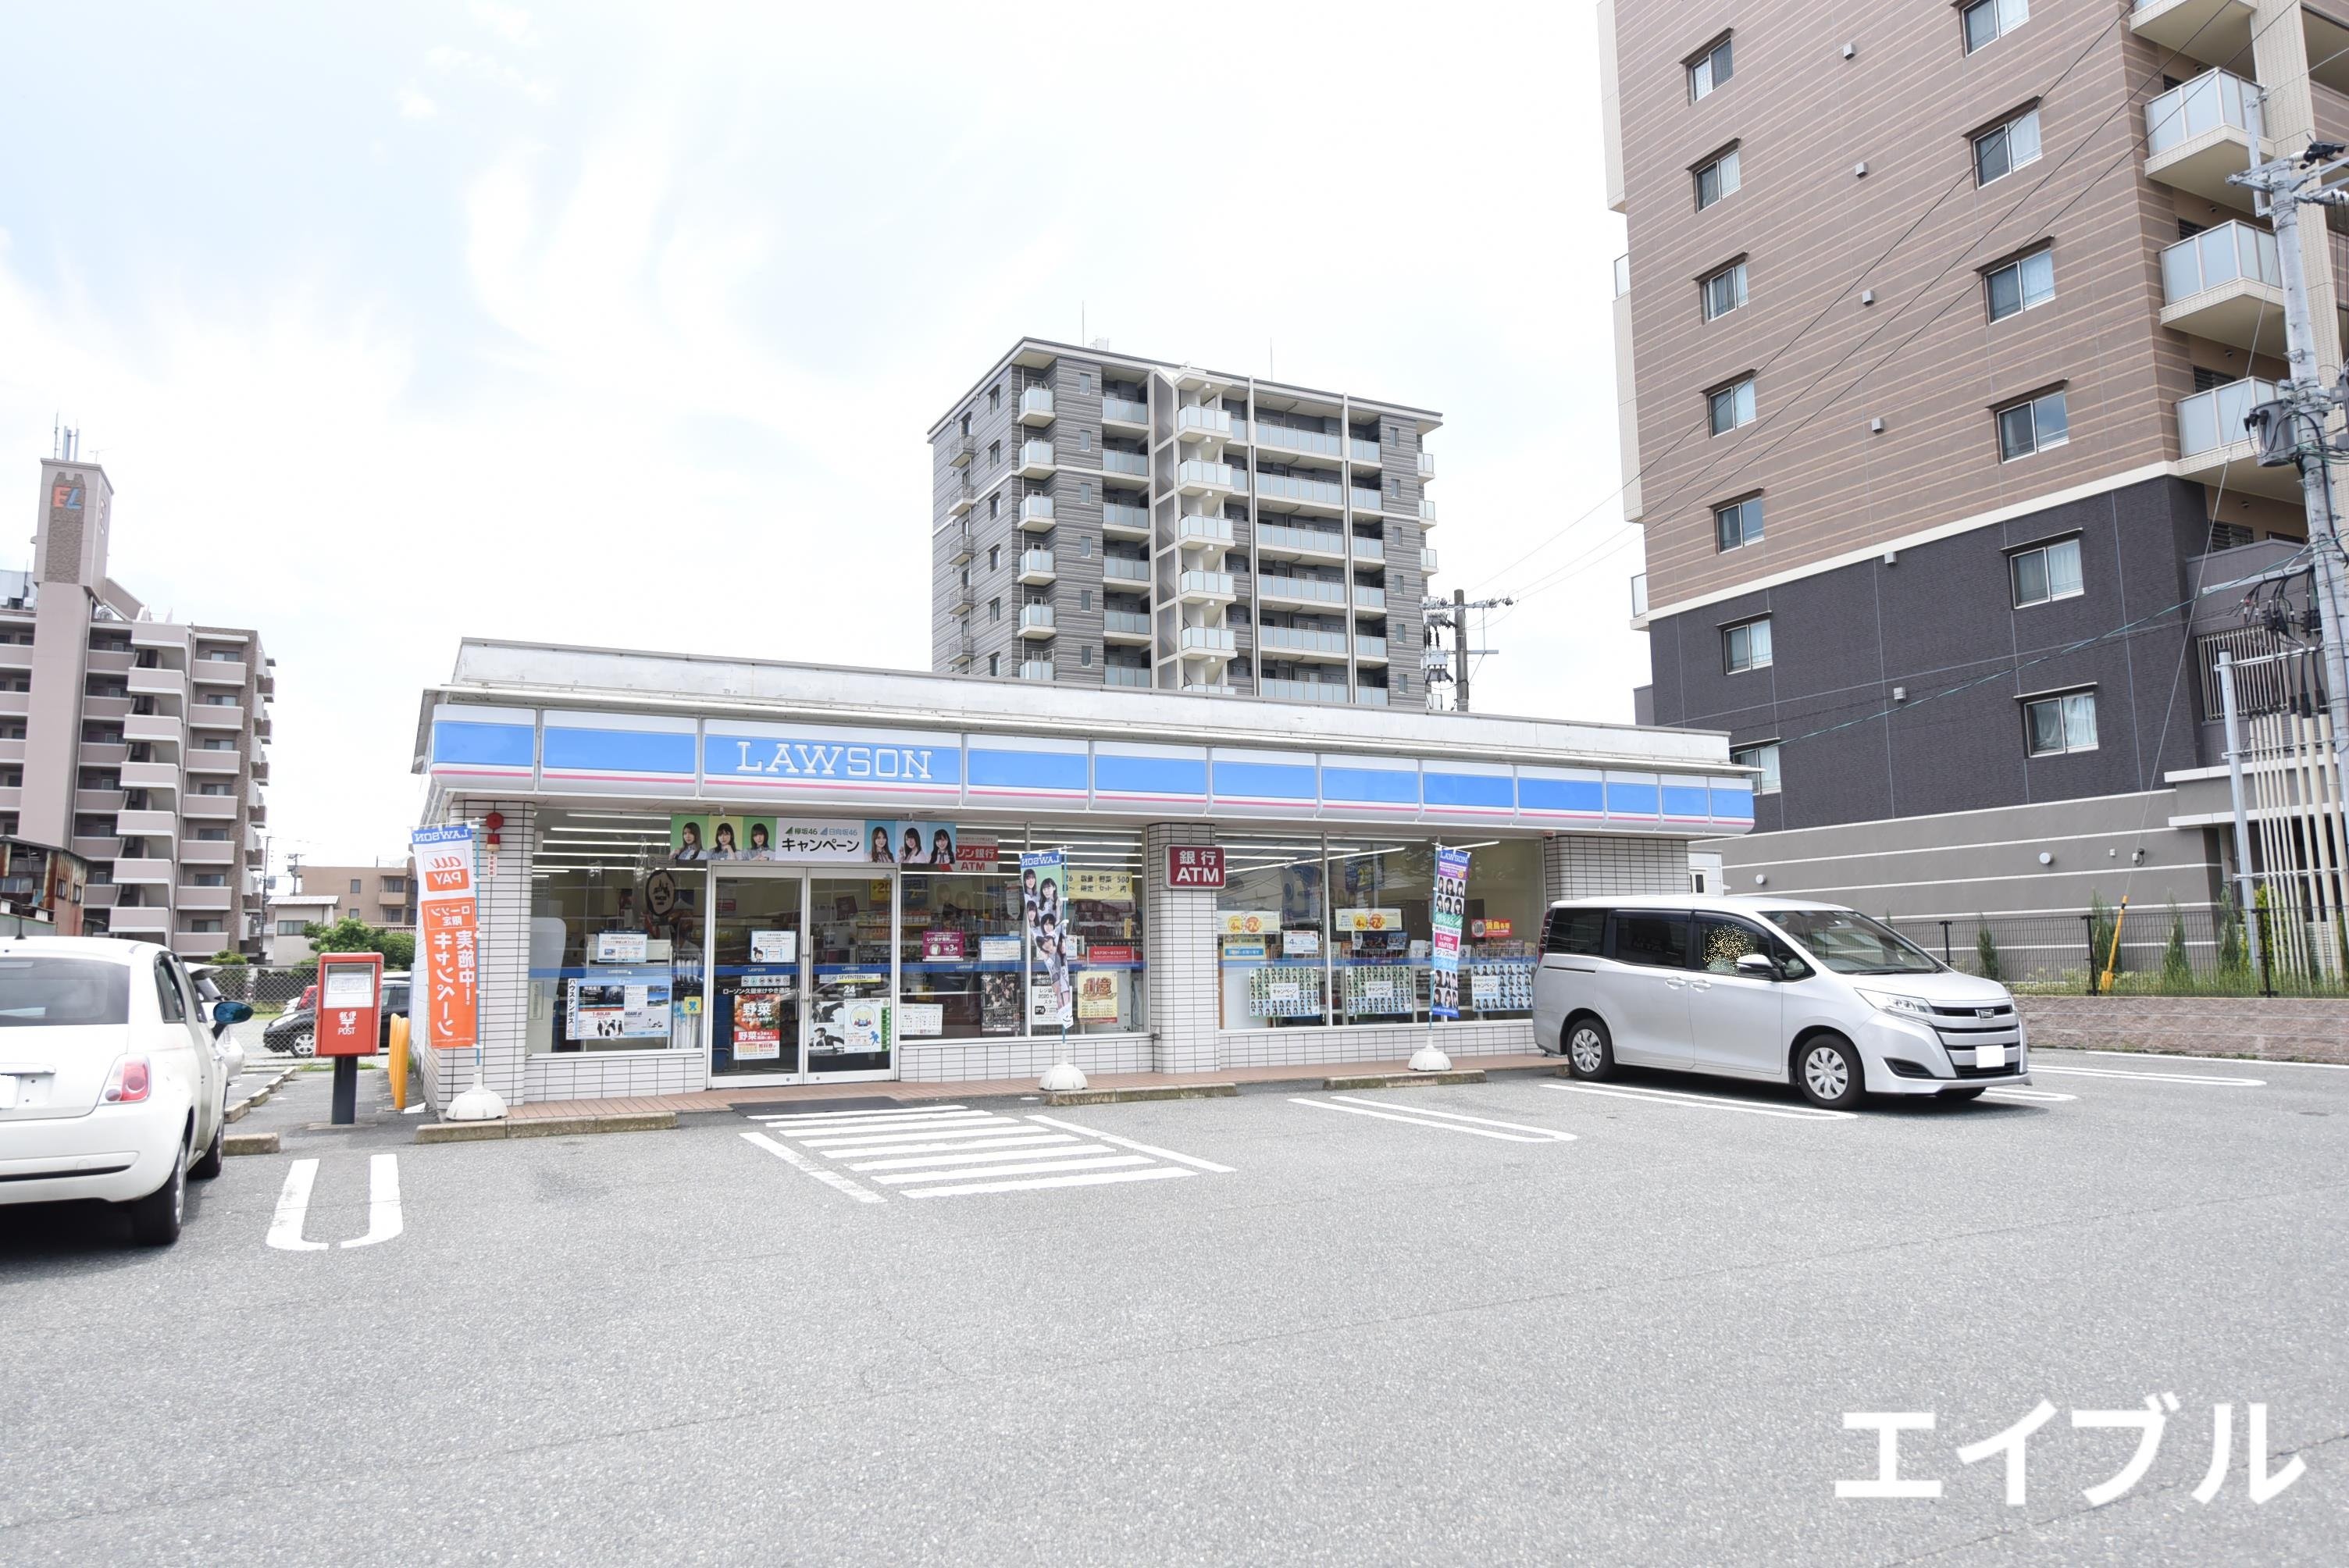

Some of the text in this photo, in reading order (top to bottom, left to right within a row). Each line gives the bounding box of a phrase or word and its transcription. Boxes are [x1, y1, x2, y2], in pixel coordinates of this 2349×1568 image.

[736, 741, 933, 779] LAWSON
[782, 838, 860, 853] キャンペーン
[1179, 850, 1217, 866] 銀行
[961, 861, 986, 871] ATM
[1176, 867, 1220, 883] ATM
[843, 985, 857, 993] 24
[568, 979, 576, 1025] ハウステンボス
[743, 1002, 772, 1017] 野菜
[337, 1027, 357, 1035] POST
[738, 1031, 757, 1041] 野菜
